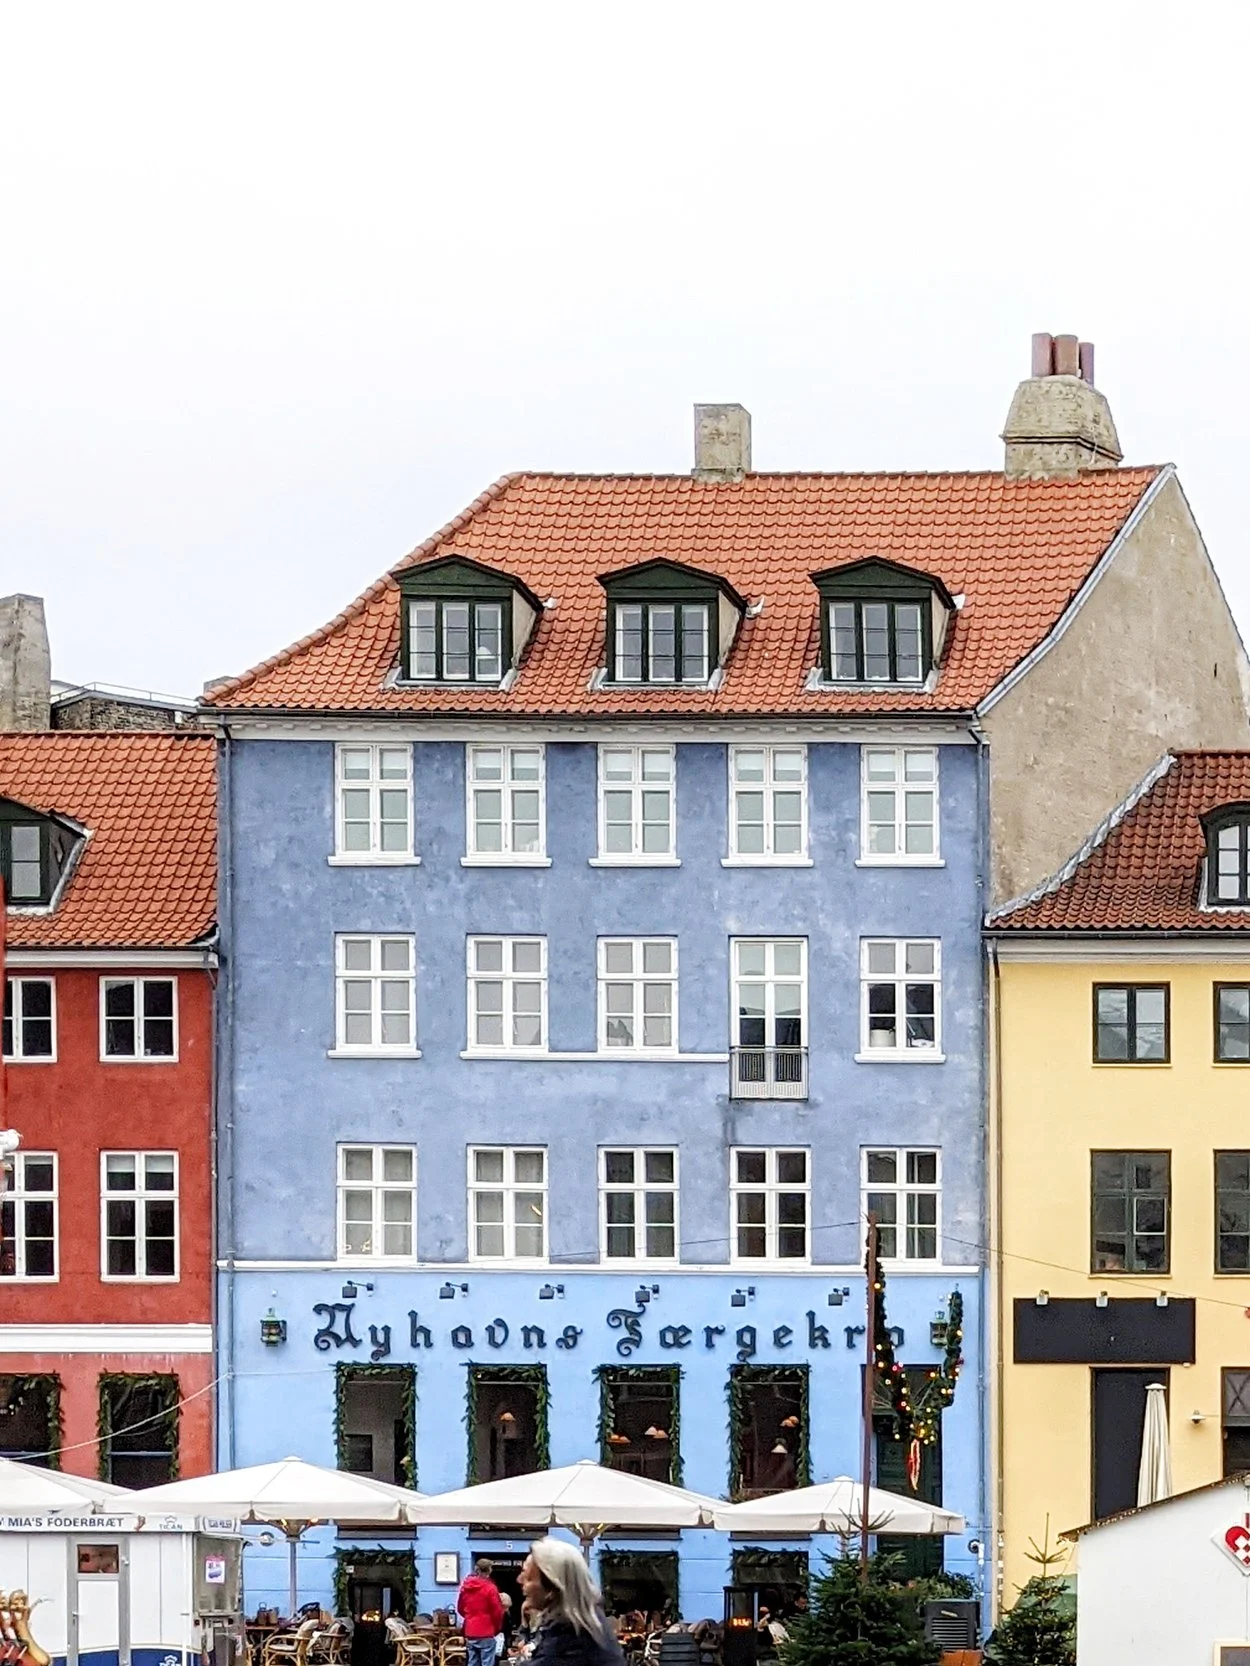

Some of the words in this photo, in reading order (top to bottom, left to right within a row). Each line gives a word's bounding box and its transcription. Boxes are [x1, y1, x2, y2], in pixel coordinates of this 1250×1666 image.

[312, 1302, 583, 1361] Nyhavns
[8, 1517, 43, 1527] MIA'S
[47, 1517, 124, 1527] FODERBRÆT
[506, 1541, 513, 1550] 5
